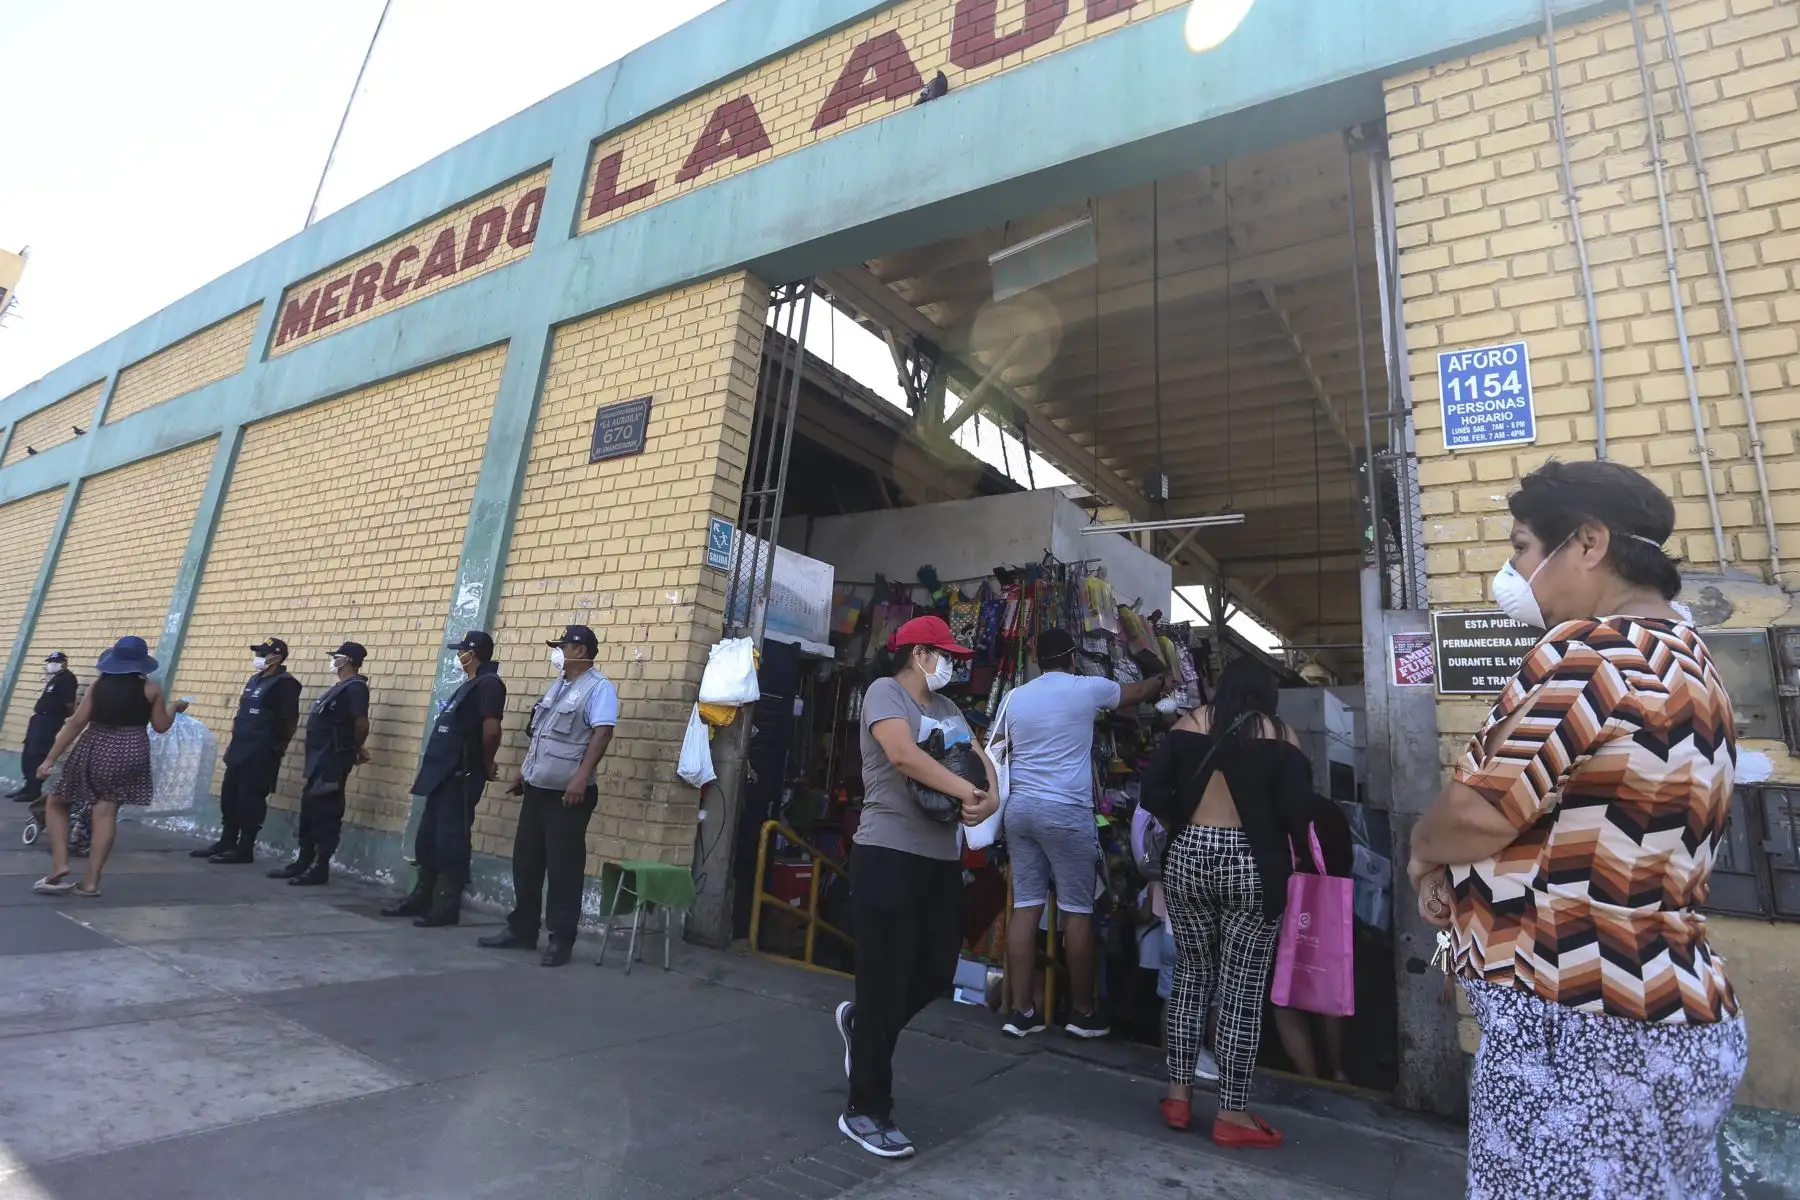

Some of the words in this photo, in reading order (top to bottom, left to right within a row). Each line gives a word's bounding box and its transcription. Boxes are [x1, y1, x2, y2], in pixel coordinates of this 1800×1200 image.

[273, 187, 546, 347] MERCADO
[587, 93, 772, 220] LA
[1447, 347, 1517, 372] AFORO
[1447, 370, 1522, 401] 1154
[1447, 396, 1526, 415] PERSONAS
[1460, 411, 1513, 425] HORARIO
[603, 424, 633, 444] 670
[708, 551, 728, 566] SALIDA
[1464, 619, 1489, 629] ESTA
[1442, 637, 1512, 648] PERMANECERA
[1448, 657, 1493, 667] DURANTE
[1494, 656, 1507, 666] EL
[1406, 666, 1434, 684] TERMO
[1472, 676, 1486, 686] DE
